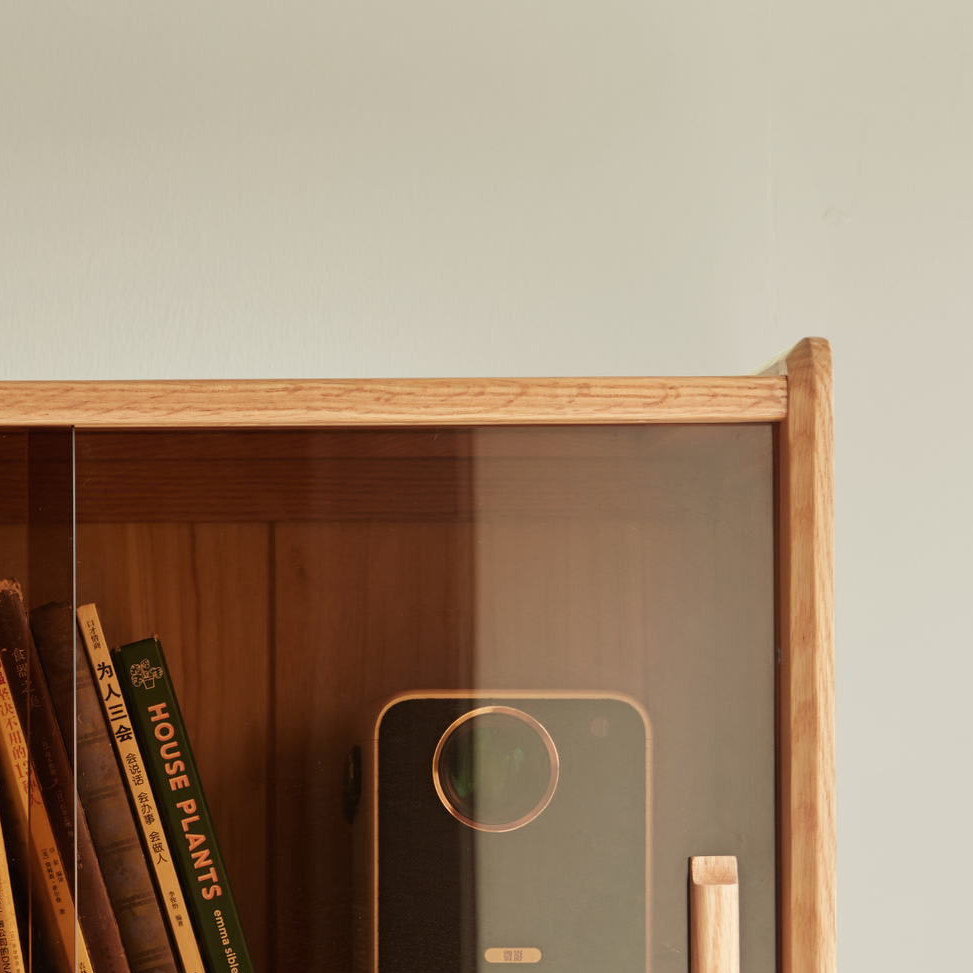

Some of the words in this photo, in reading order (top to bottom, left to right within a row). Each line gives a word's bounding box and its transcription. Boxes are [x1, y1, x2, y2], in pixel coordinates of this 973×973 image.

[97, 662, 133, 743] 为人三会
[126, 753, 145, 786] 会说话
[137, 792, 155, 825] 会办事
[149, 831, 168, 865] 会做人
[147, 702, 191, 792] HOUSE
[176, 798, 223, 901] PLANTS
[213, 908, 230, 946] emma
